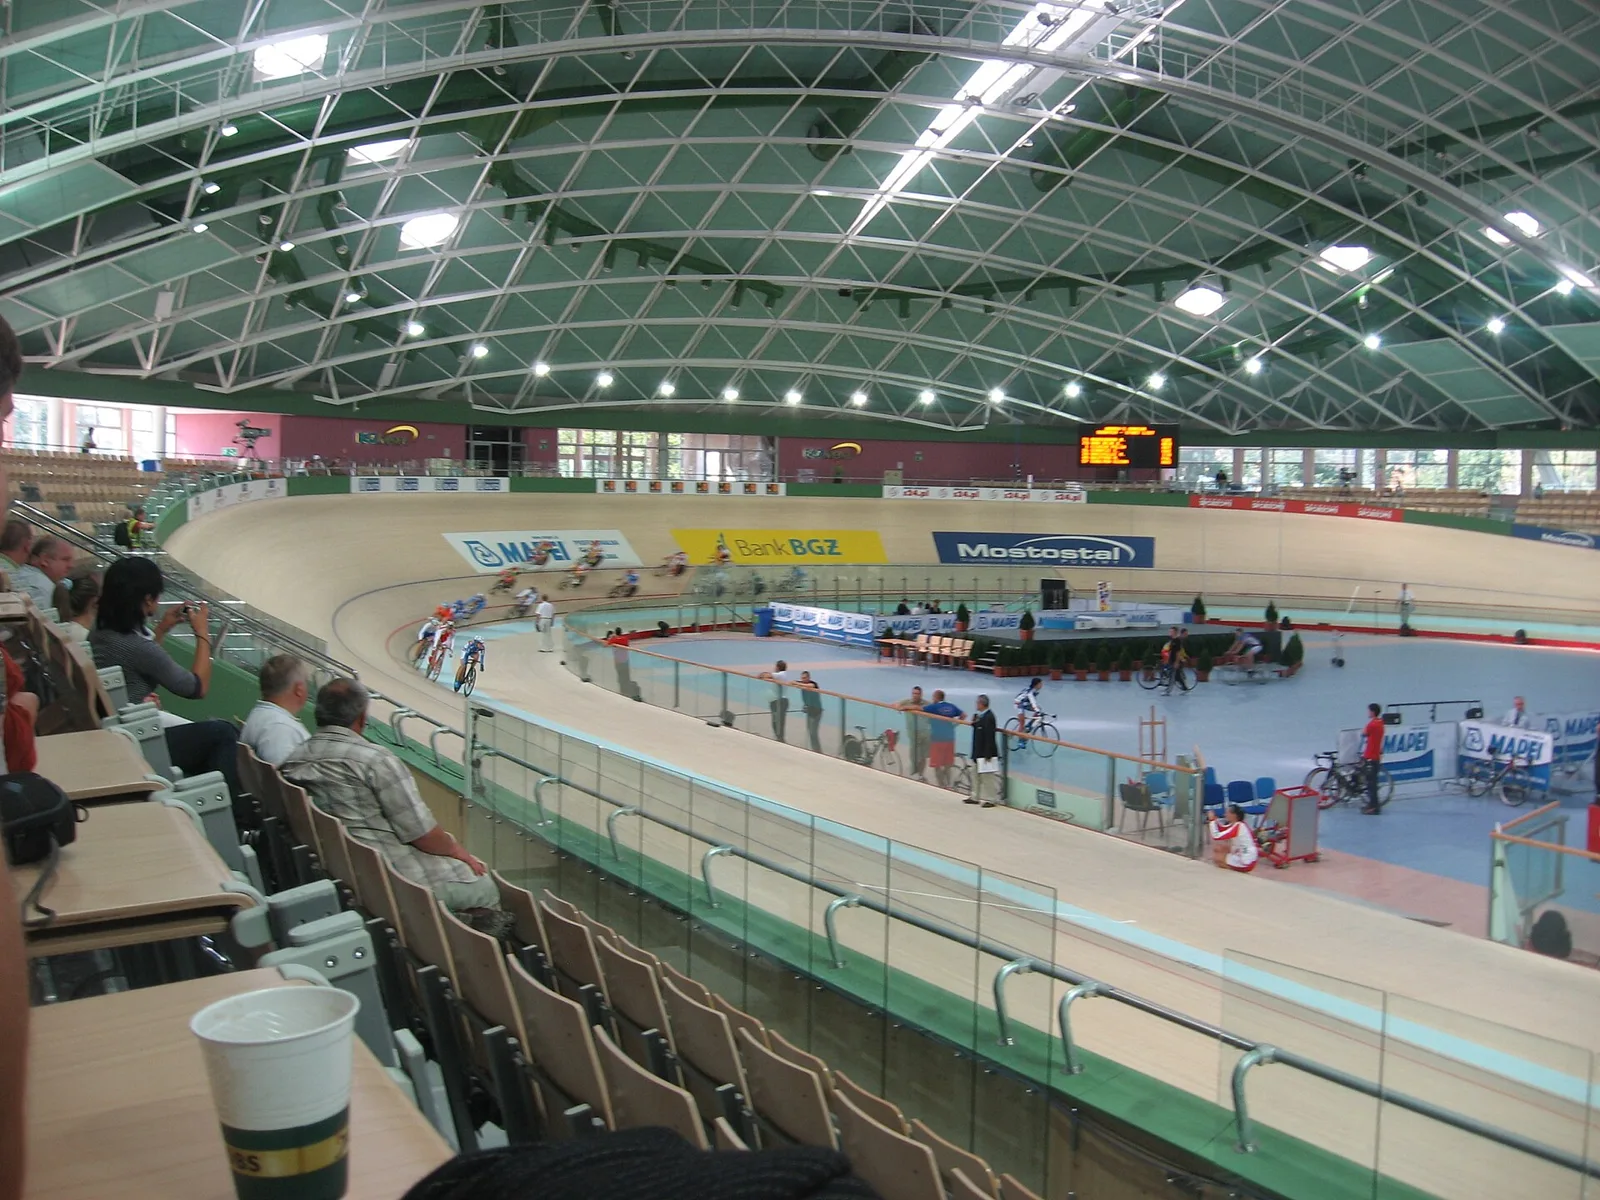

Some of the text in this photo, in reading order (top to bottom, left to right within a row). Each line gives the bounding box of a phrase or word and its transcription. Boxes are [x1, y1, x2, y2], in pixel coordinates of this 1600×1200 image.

[734, 538, 791, 556] Bank
[957, 543, 1120, 560] Mostostal
[1383, 731, 1429, 753] MAPEI
[1488, 733, 1544, 760] MAPEI
